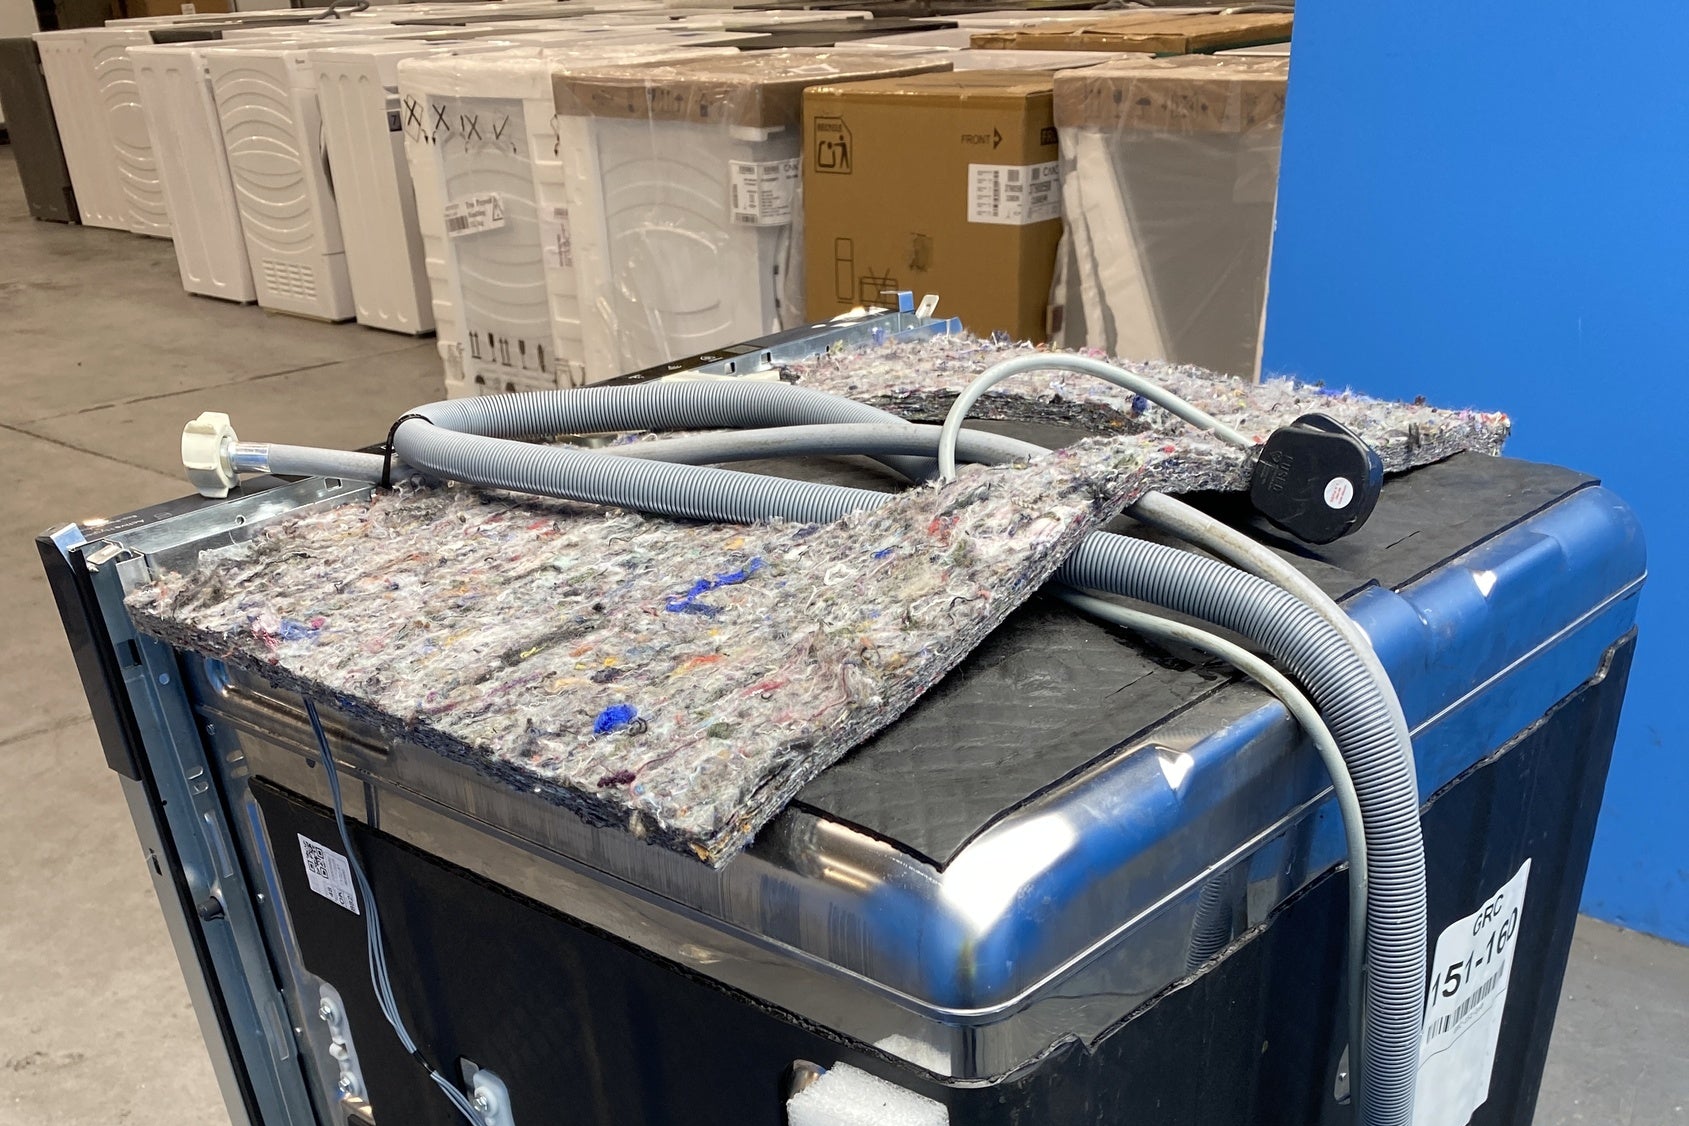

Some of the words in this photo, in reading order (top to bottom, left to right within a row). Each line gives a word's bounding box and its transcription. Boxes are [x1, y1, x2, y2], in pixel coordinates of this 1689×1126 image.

[960, 134, 991, 144] FRONT
[1472, 894, 1504, 936] GRC
[1431, 907, 1518, 1007] 151-160
